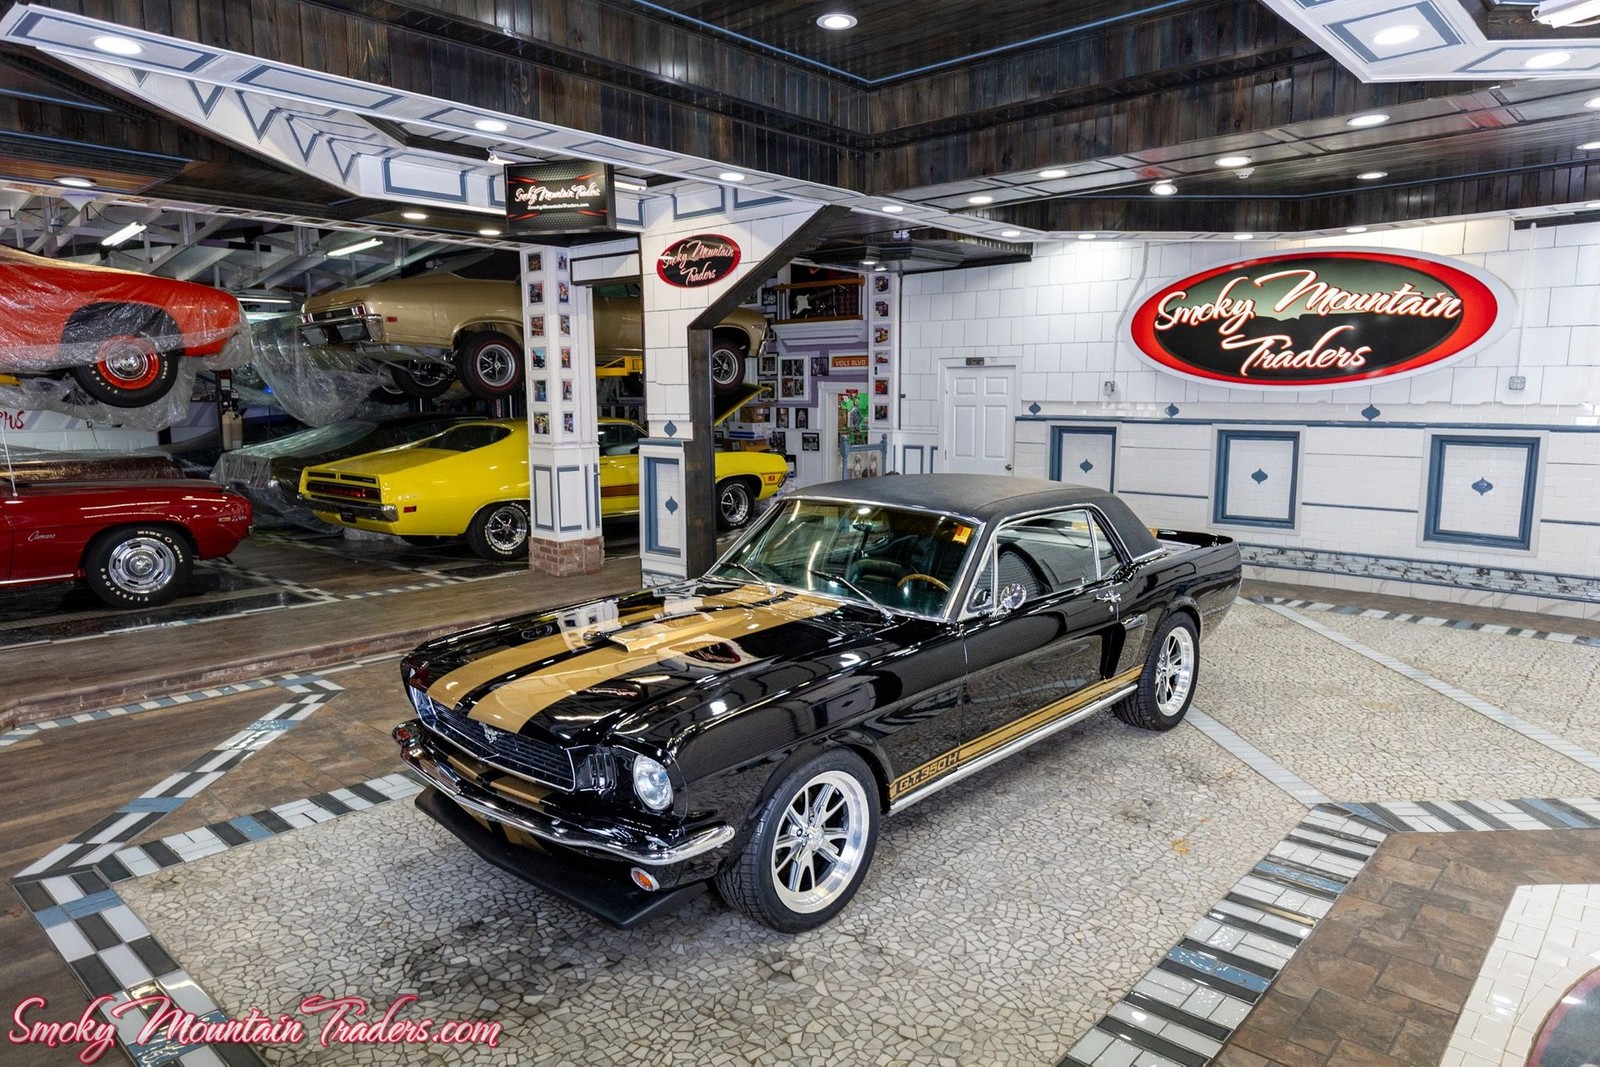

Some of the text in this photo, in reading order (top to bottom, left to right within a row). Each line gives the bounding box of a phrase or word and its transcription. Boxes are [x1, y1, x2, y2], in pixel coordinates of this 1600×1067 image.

[514, 182, 601, 205] Smoky Mountain Traders
[686, 240, 735, 259] Mountain
[679, 261, 717, 286] Traders
[1154, 269, 1463, 336] Smoky Mountain
[1221, 325, 1372, 377] Traders
